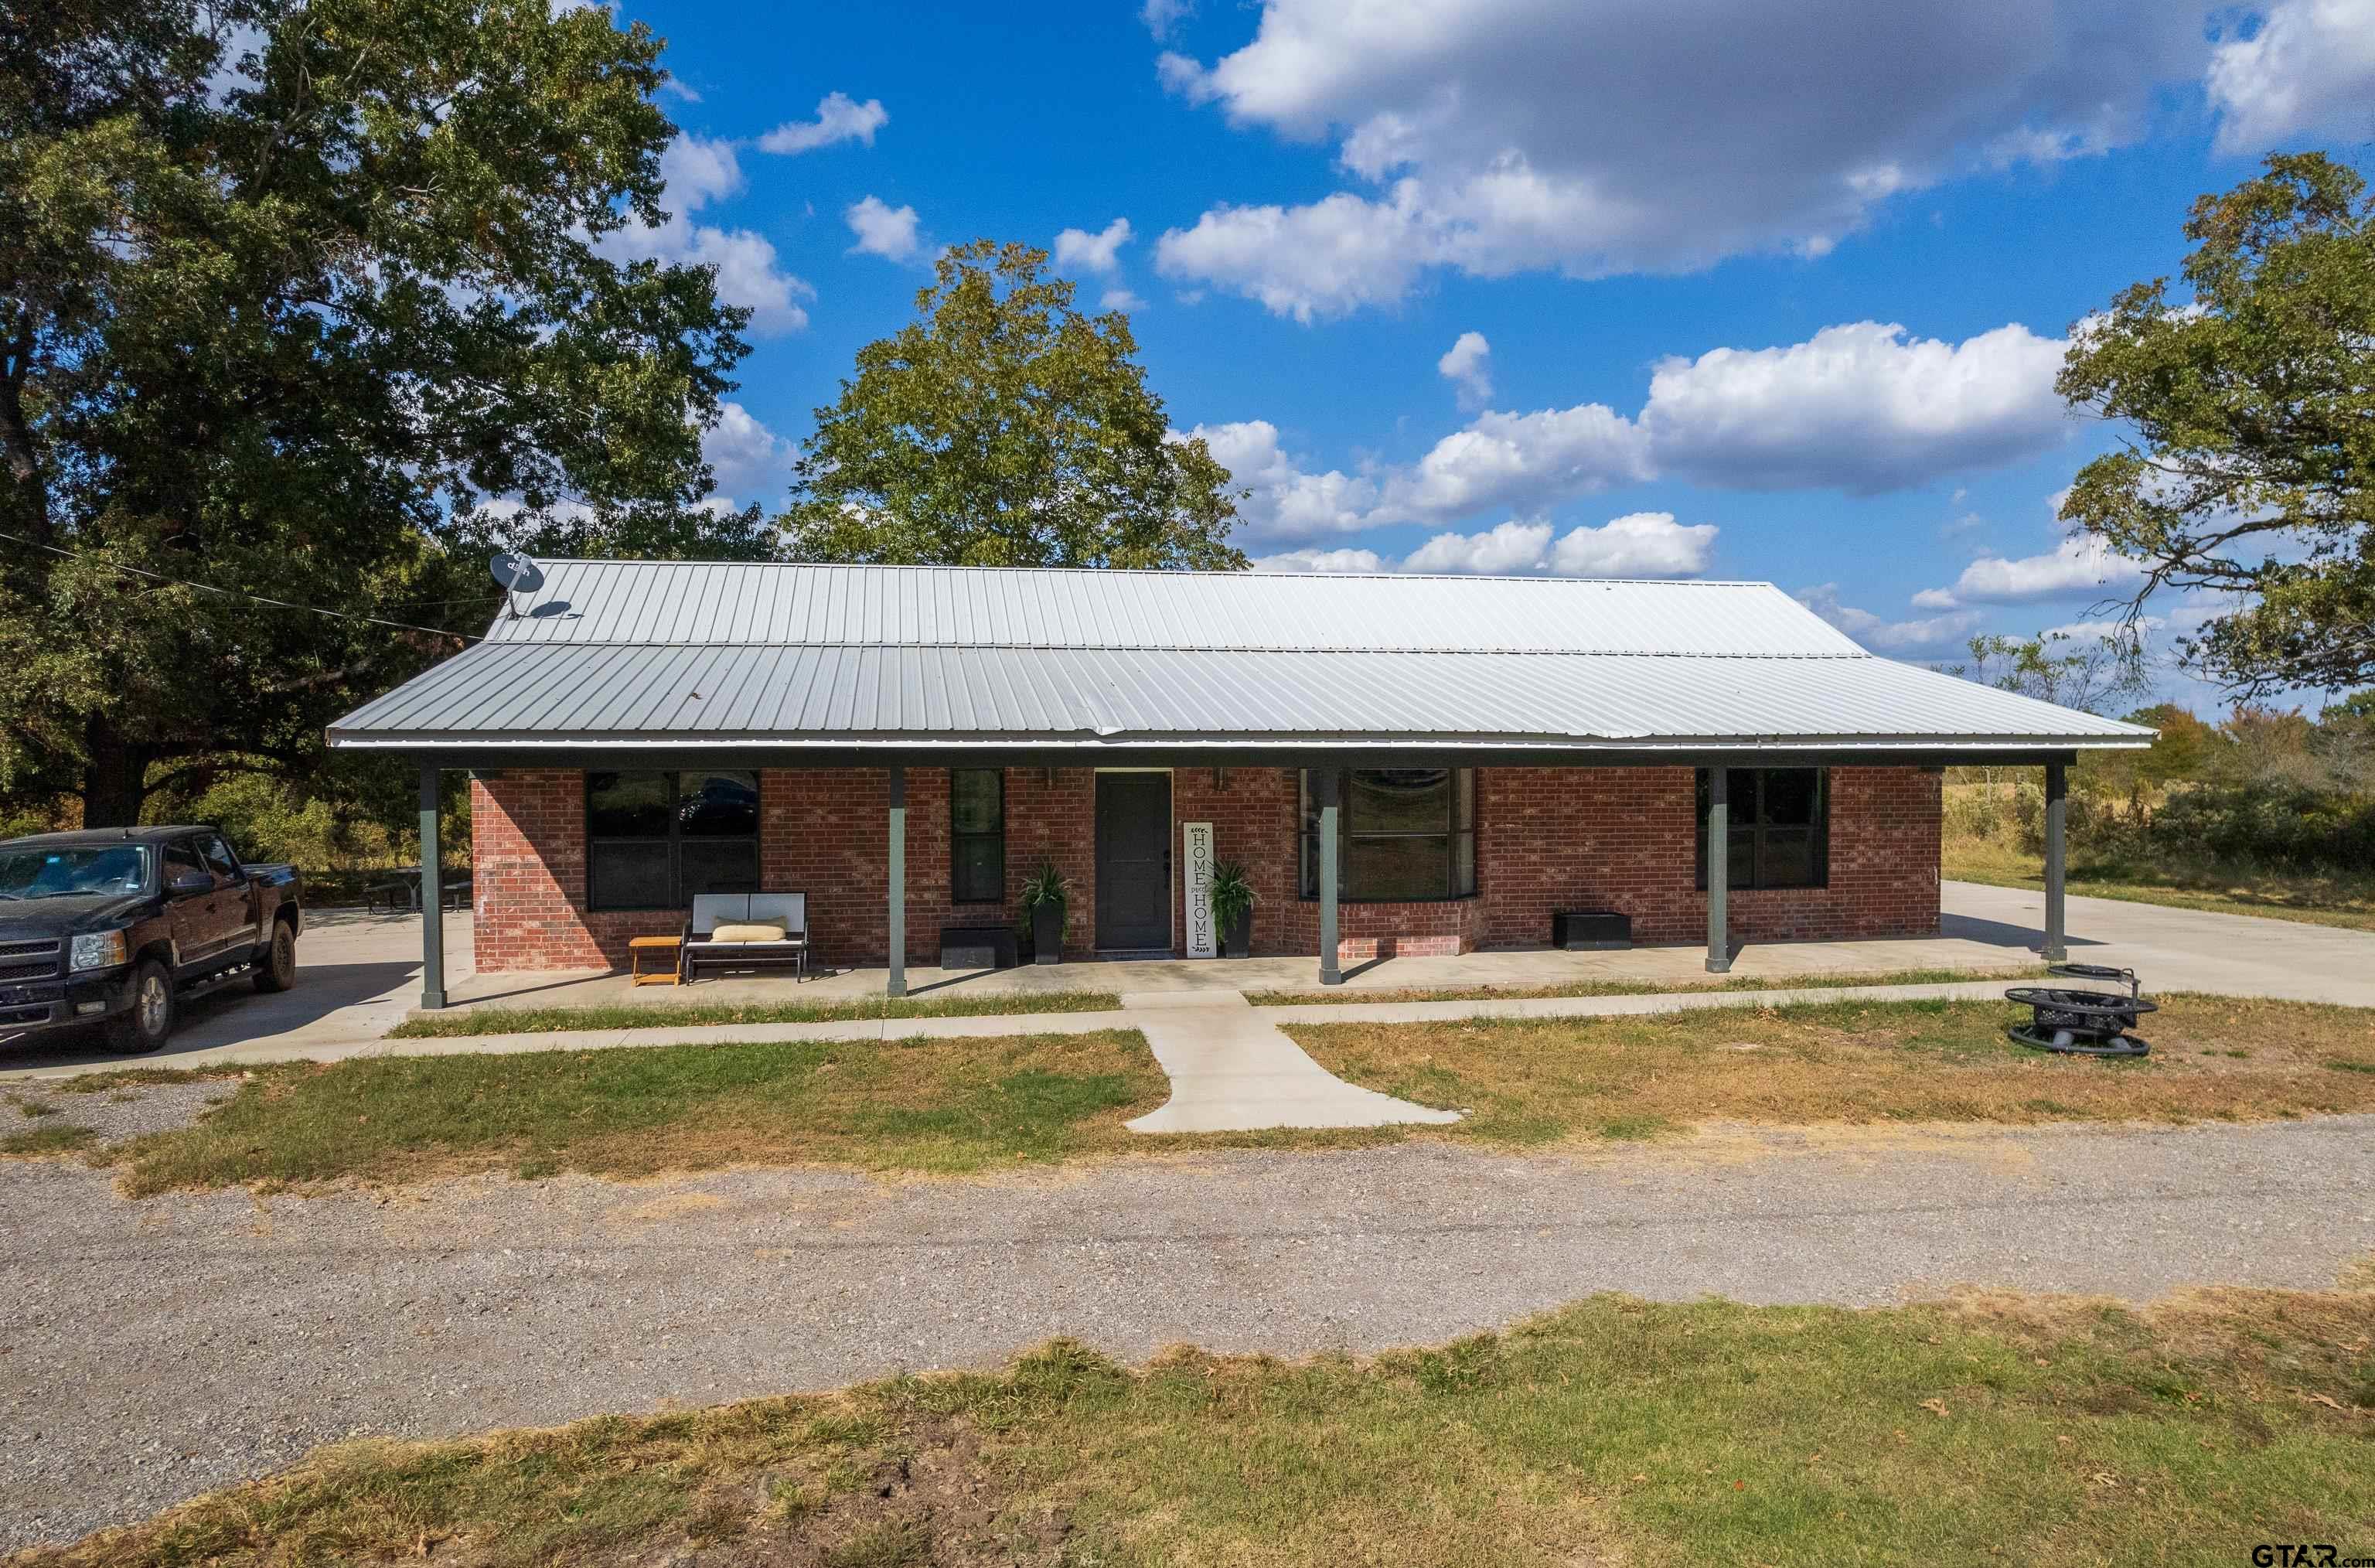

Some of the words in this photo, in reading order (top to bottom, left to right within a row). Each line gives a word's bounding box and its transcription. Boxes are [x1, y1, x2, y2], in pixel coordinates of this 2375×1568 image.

[507, 562, 530, 577] dh
[1193, 833, 1206, 885] HOME
[1194, 894, 1207, 946] HOME
